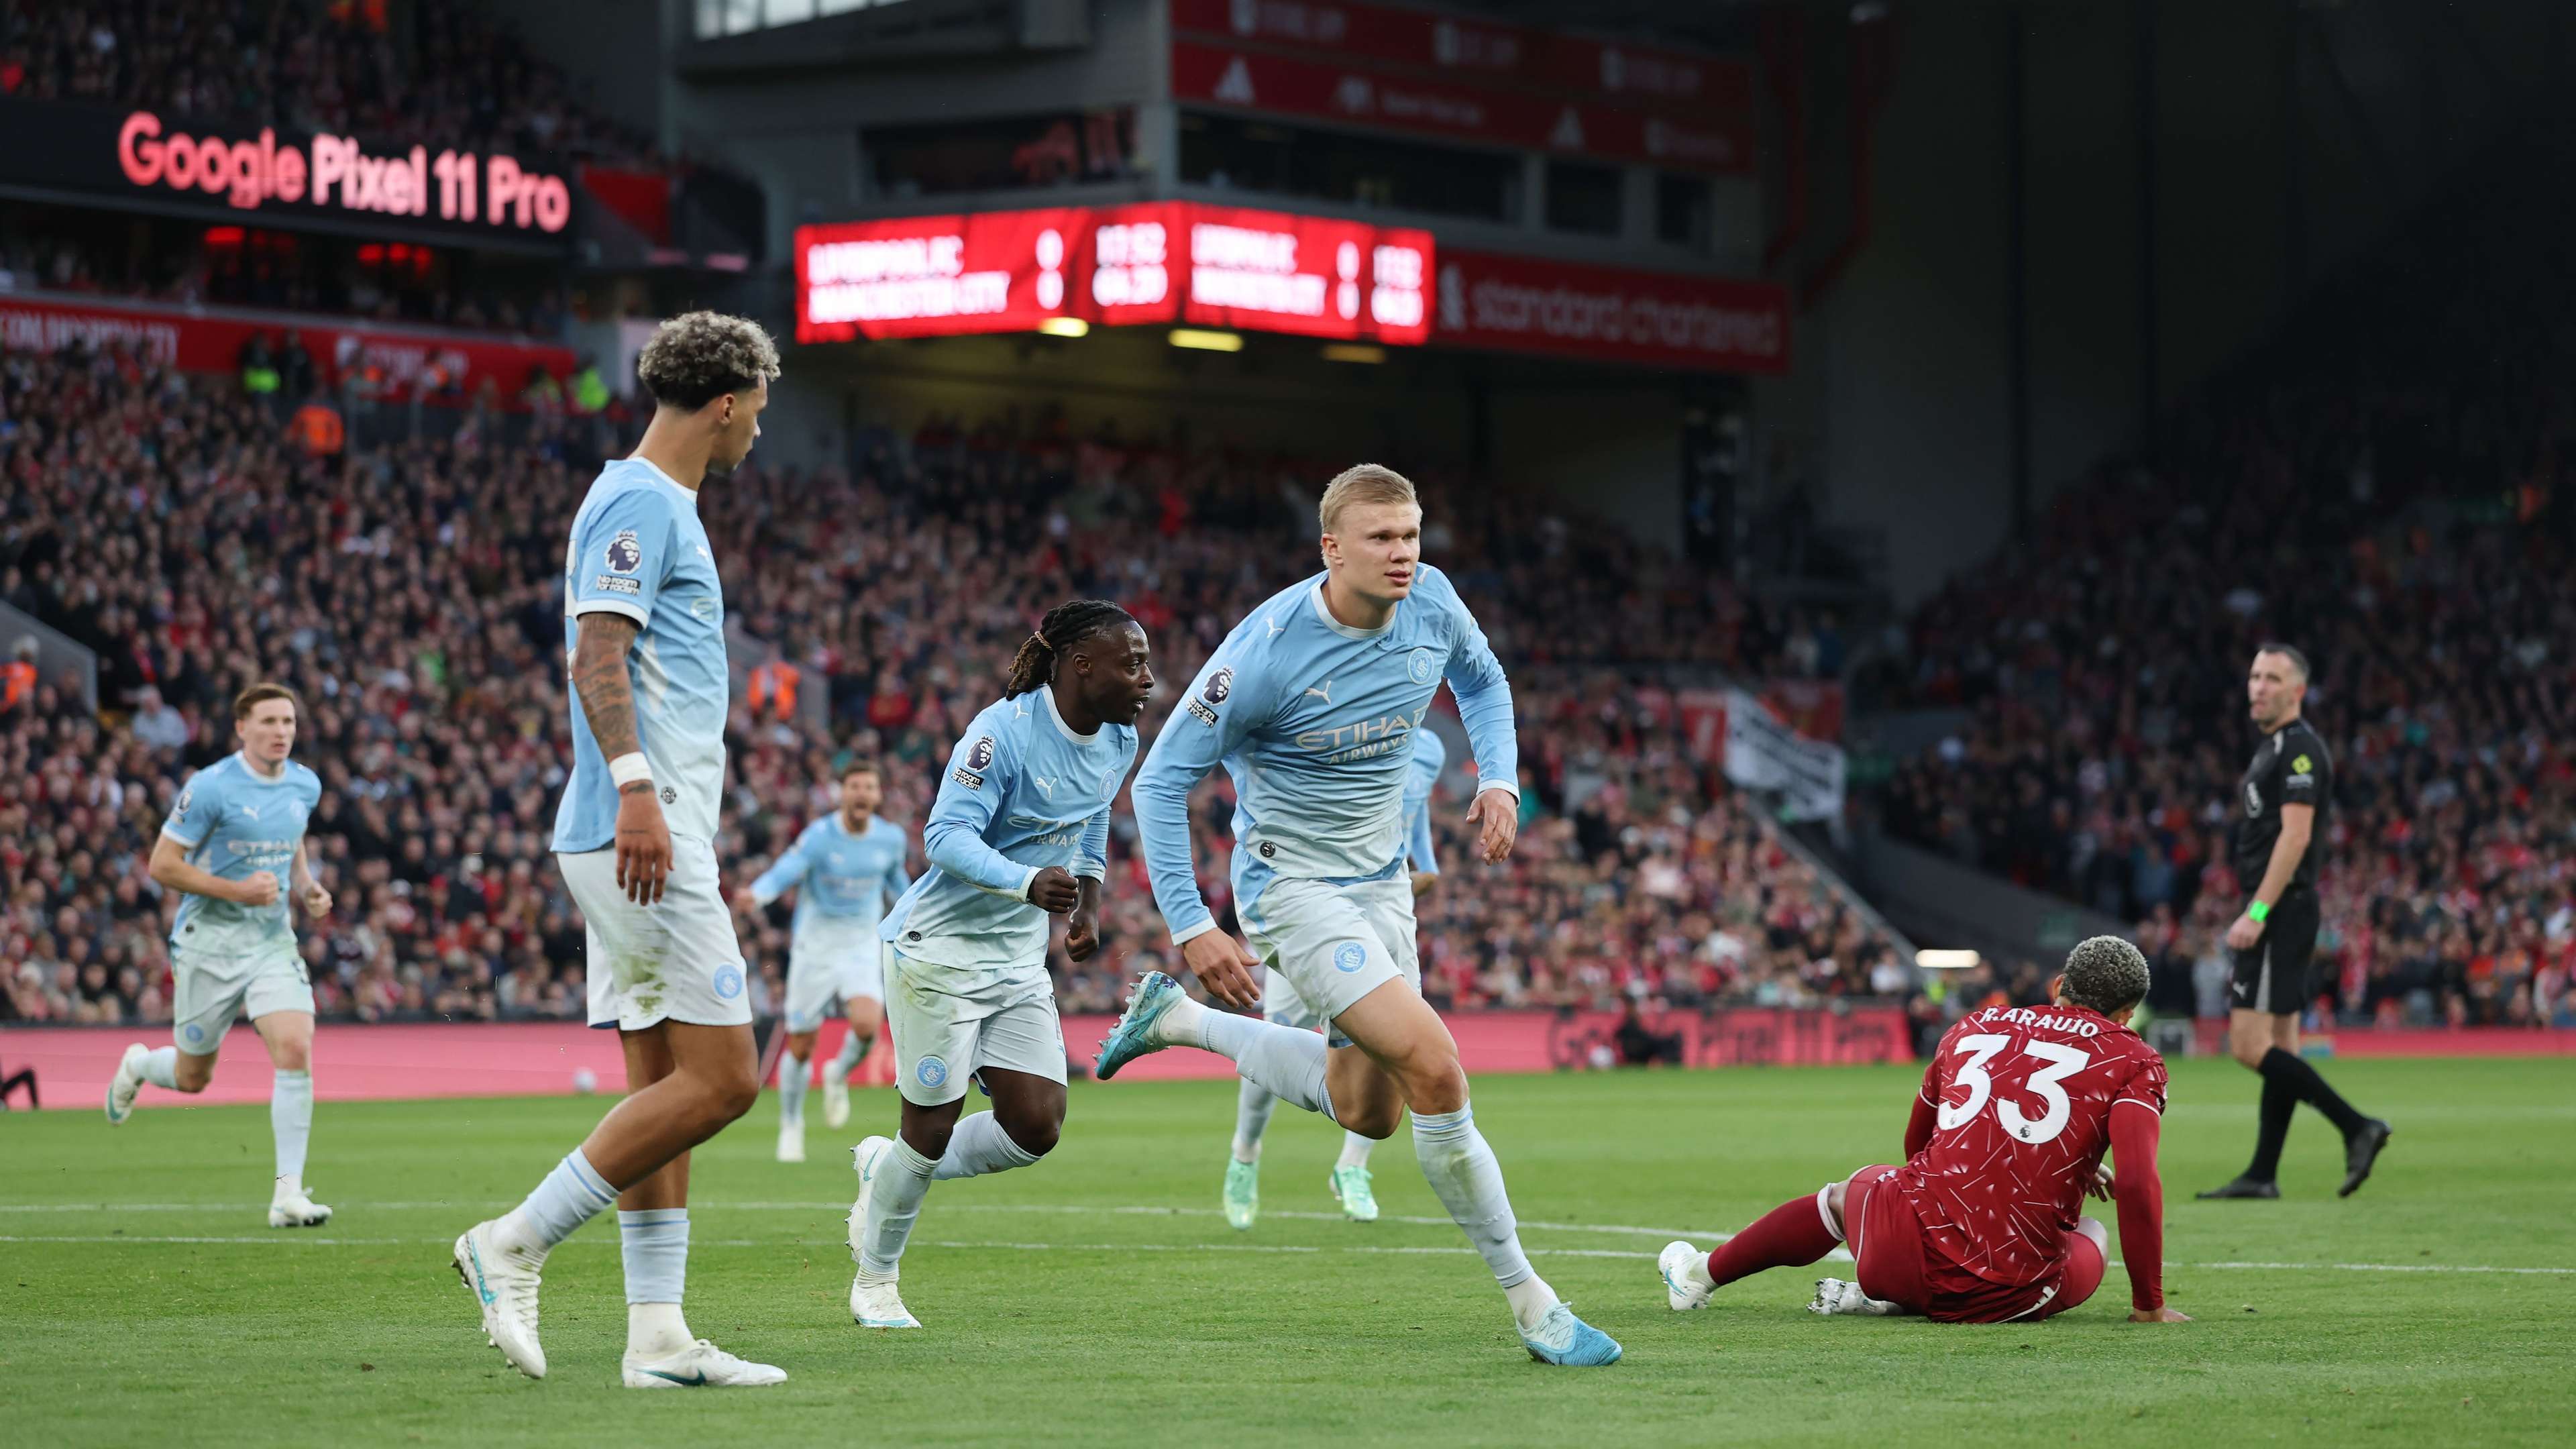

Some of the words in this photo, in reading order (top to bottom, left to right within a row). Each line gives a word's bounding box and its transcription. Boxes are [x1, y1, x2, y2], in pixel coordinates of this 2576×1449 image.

[118, 111, 308, 210] Google
[311, 131, 428, 217] Pixel
[433, 148, 478, 222] 11
[486, 154, 571, 233] Pro
[1195, 702, 1215, 720] room
[961, 771, 980, 784] room
[1937, 1033, 2091, 1144] 33
